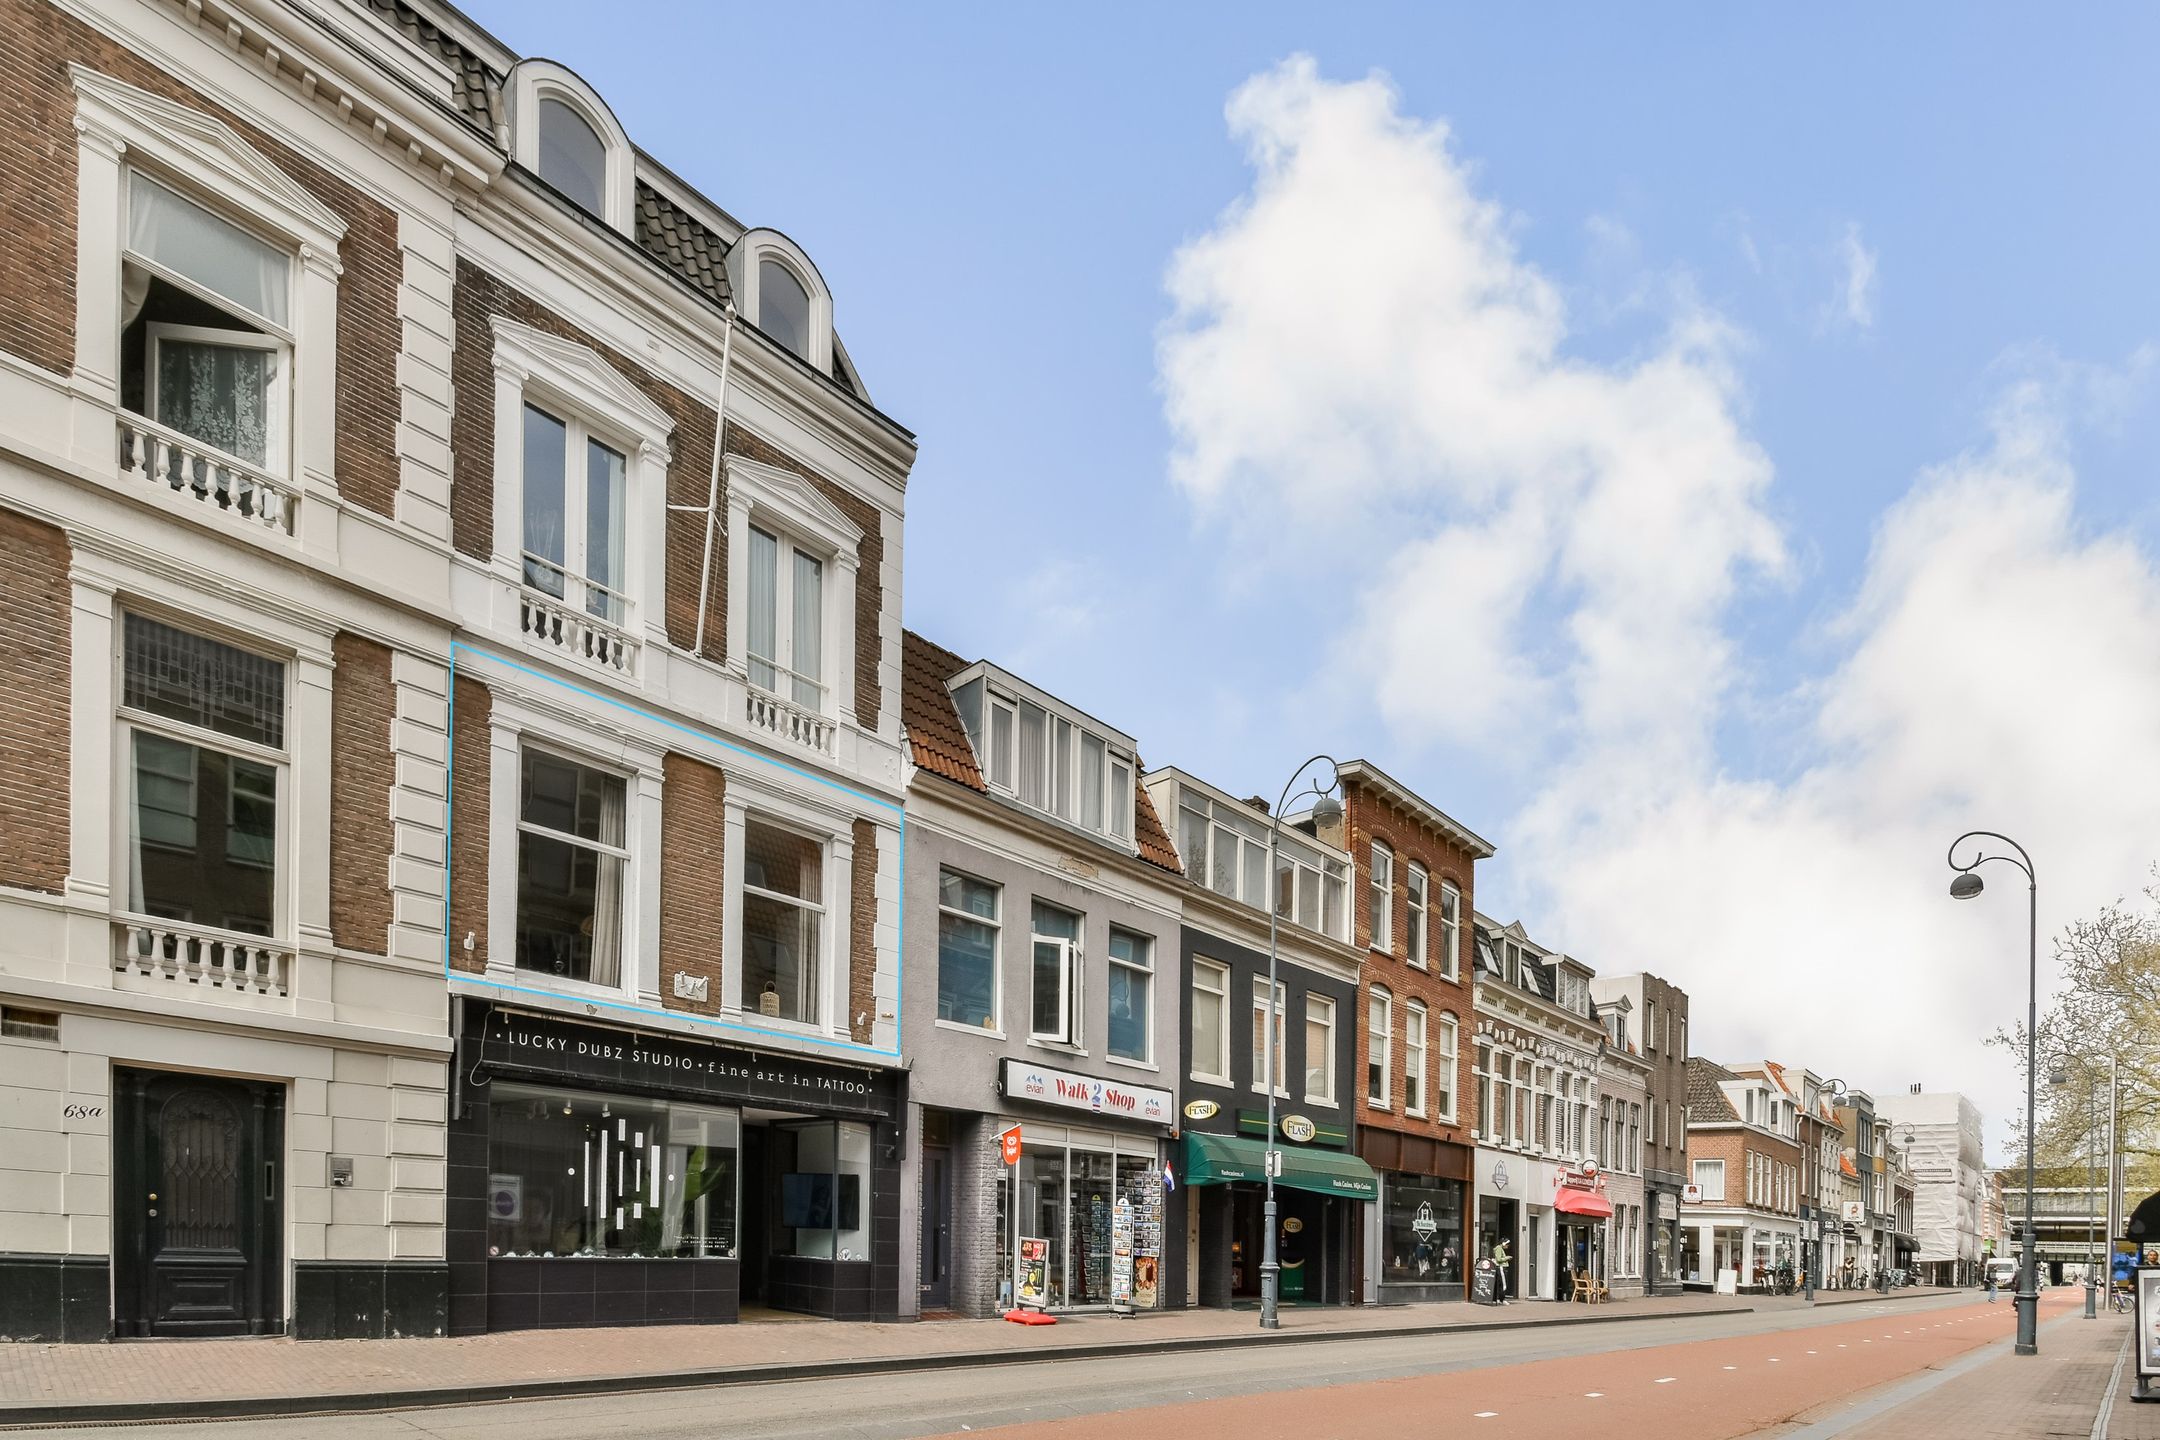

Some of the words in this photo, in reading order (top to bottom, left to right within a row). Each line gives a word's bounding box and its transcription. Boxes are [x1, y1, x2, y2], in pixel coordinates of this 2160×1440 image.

[509, 1031, 567, 1051] LUCKY
[578, 1041, 623, 1060] DUBZ
[632, 1050, 692, 1070] STUDIO
[708, 1061, 749, 1078] fine
[756, 1070, 785, 1083] art
[792, 1074, 809, 1087] in
[816, 1077, 865, 1094] TATTOO
[1026, 1084, 1044, 1095] evian
[1056, 1078, 1089, 1101] Walk
[1092, 1083, 1102, 1104] 2
[1105, 1088, 1136, 1111] Shop
[63, 1104, 106, 1120] 68a
[1145, 1107, 1161, 1117] evian
[1189, 1104, 1213, 1115] FLASH
[1287, 1120, 1312, 1137] FLASH
